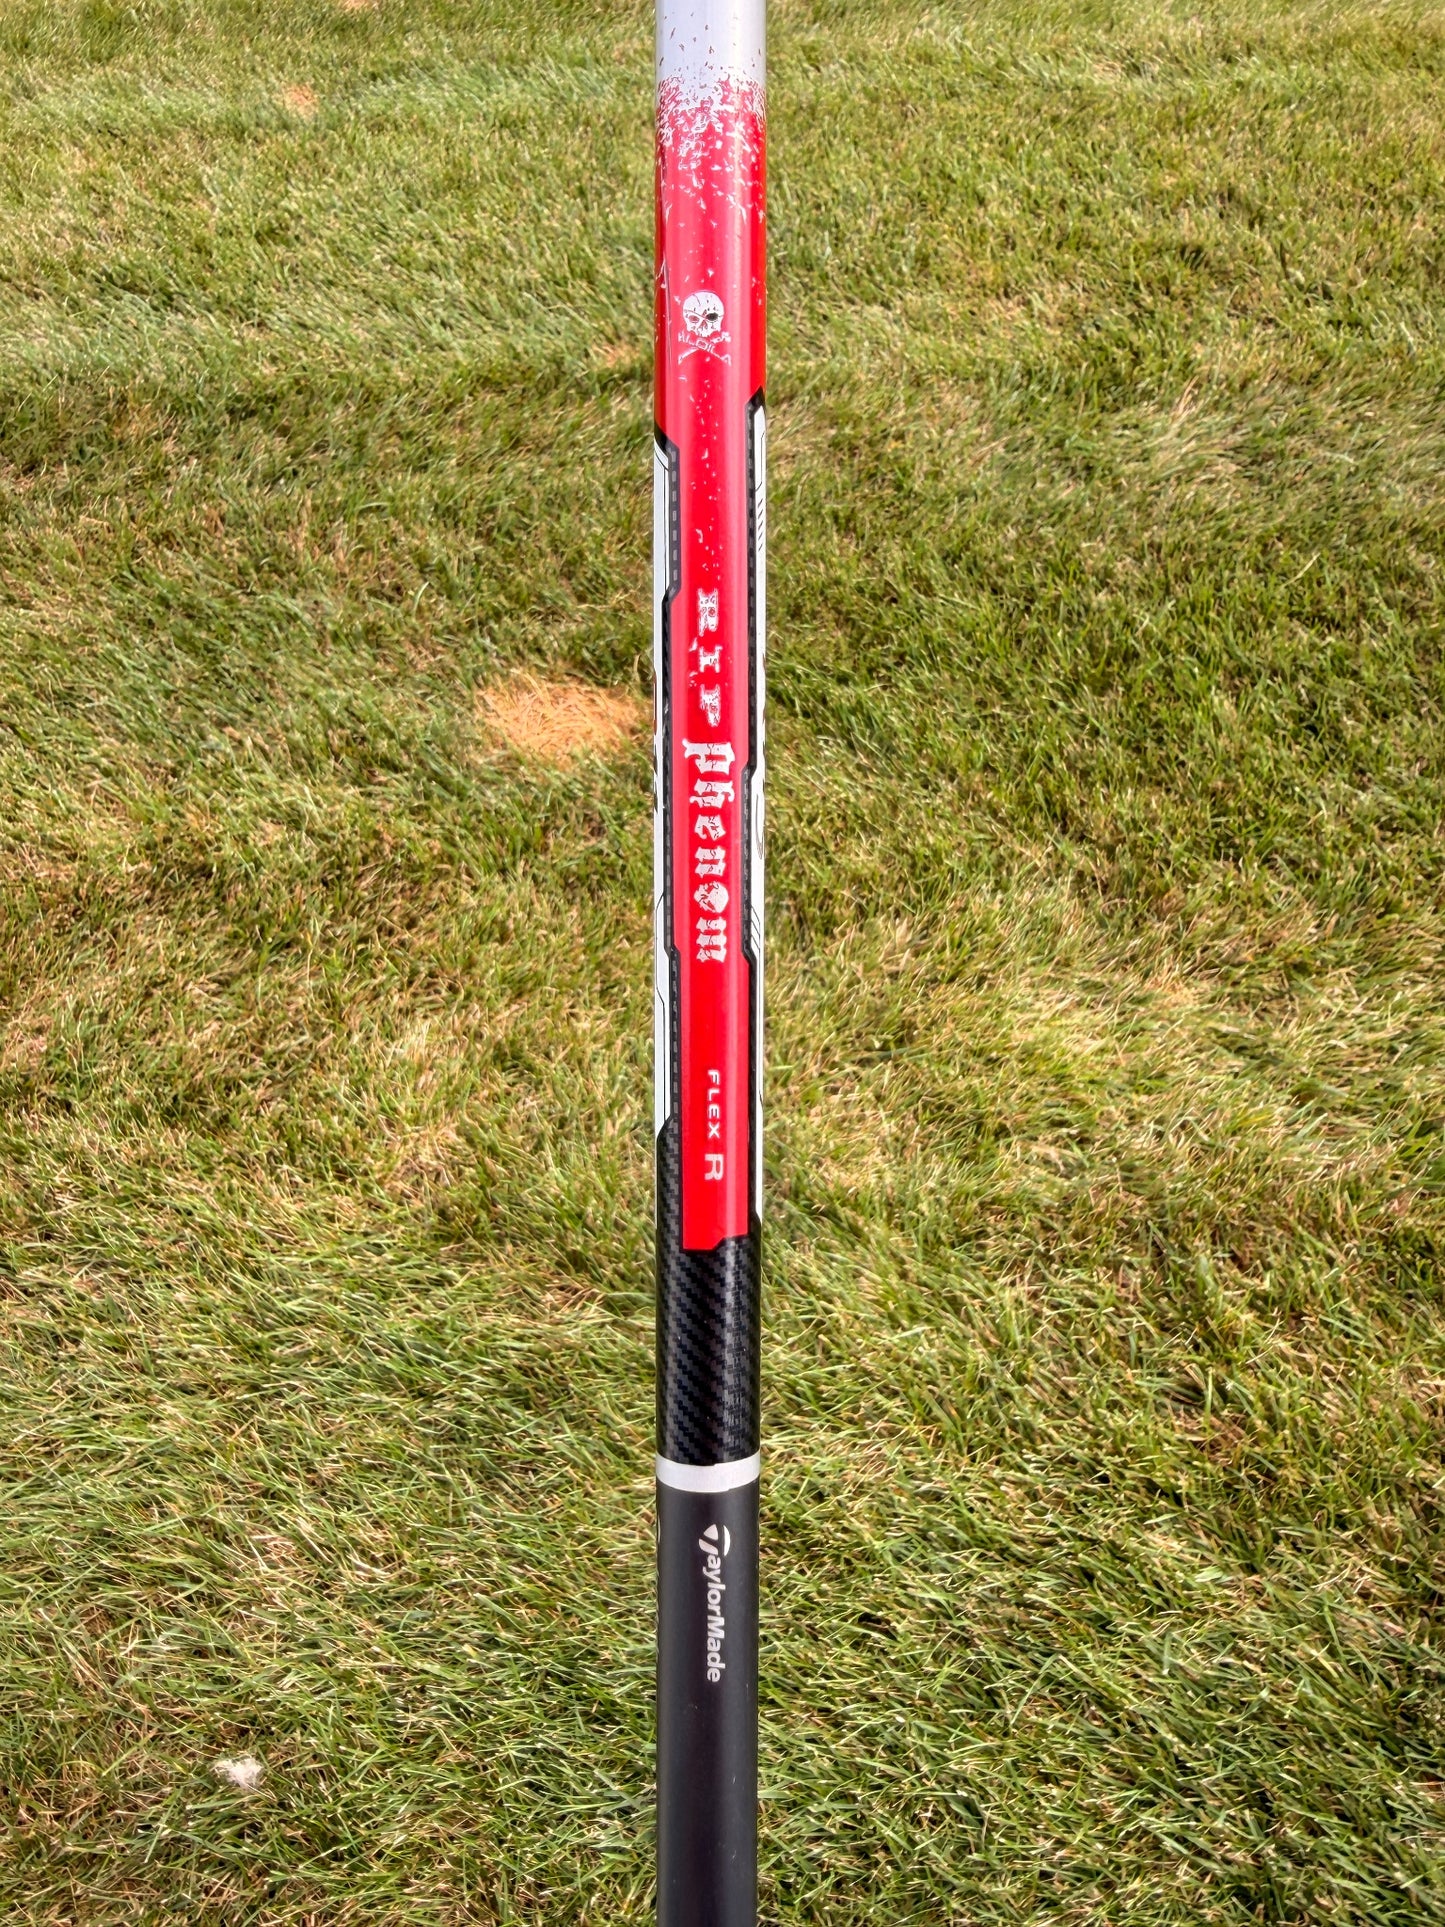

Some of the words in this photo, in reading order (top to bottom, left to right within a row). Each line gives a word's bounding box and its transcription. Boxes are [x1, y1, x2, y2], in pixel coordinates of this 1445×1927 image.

[697, 588, 722, 727] RIP
[707, 1069, 720, 1139] FLEX
[704, 1153, 724, 1181] R
[698, 1524, 731, 1683] TaylorMade
